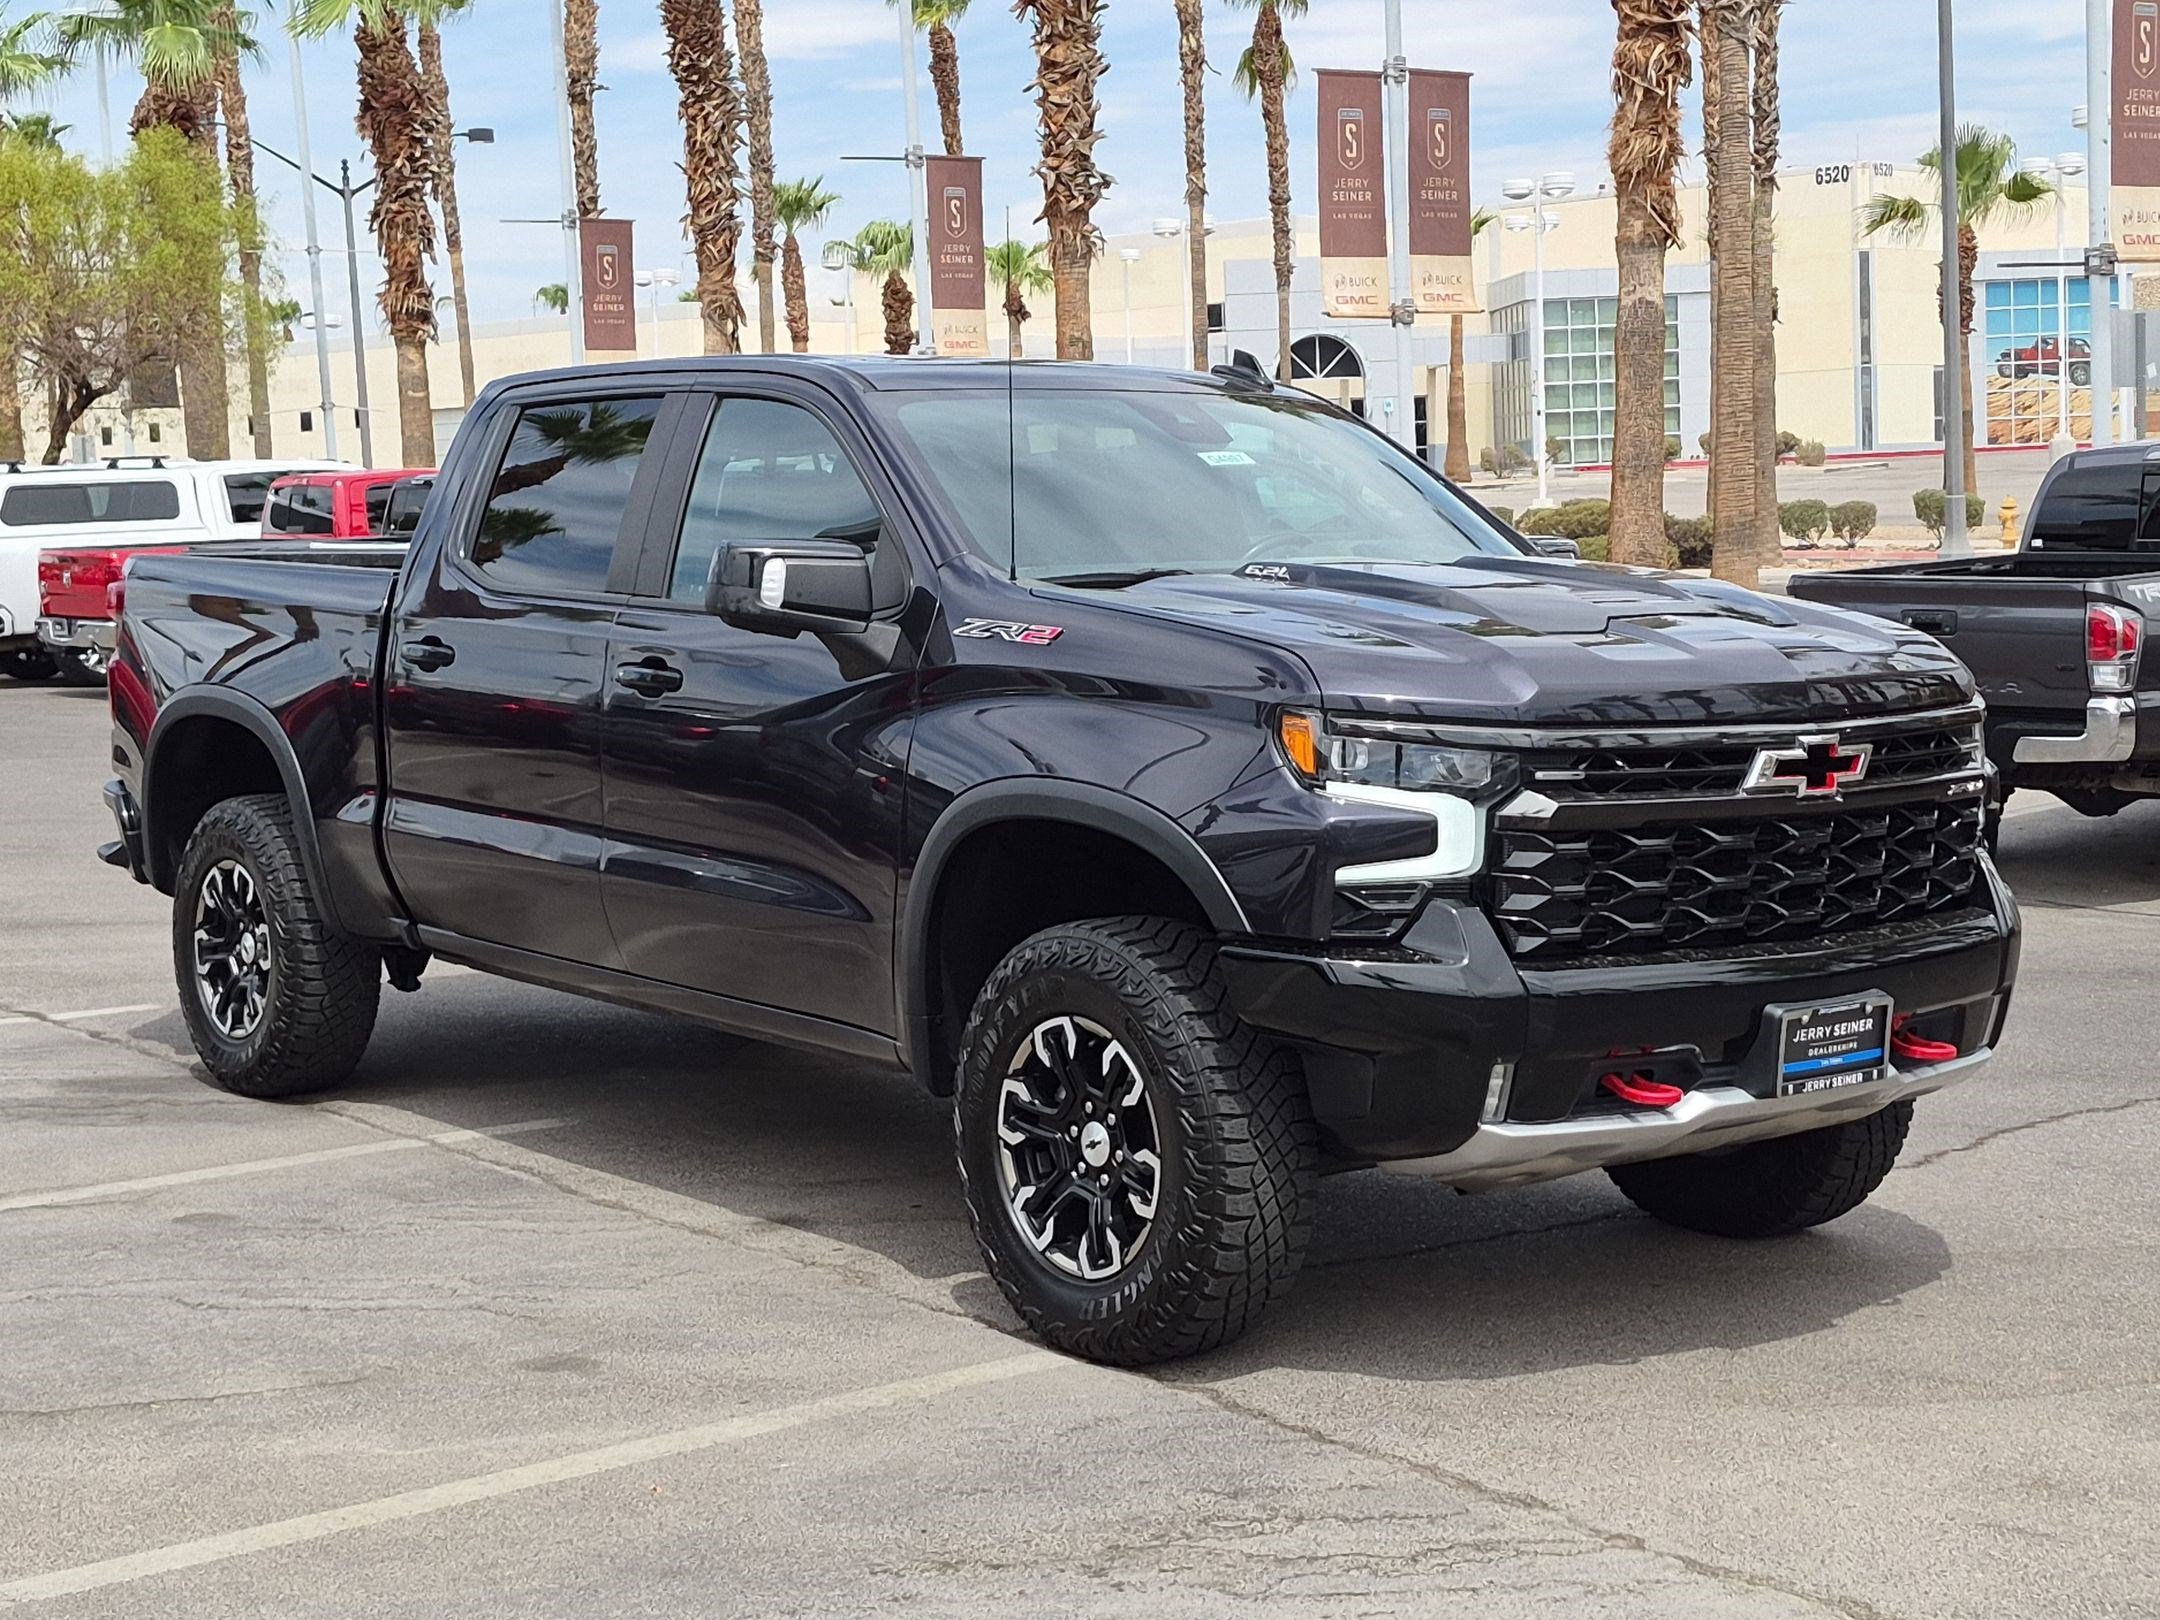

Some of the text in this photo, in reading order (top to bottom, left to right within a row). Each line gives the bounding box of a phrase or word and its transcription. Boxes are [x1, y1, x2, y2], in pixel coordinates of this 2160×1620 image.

[2126, 88, 2160, 100] JERRY
[1815, 164, 1850, 185] 6520
[1873, 163, 1893, 177] 6520
[1334, 178, 1369, 189] JERRY
[1423, 177, 1455, 188] JERRY
[1332, 191, 1372, 201] SEINER
[1420, 190, 1458, 201] SEINER
[943, 244, 971, 254] JERRY
[940, 254, 974, 264] SEINER
[1348, 277, 1377, 287] BUICK
[1436, 275, 1463, 285] BUICK
[1336, 295, 1378, 305] GMC
[1423, 293, 1465, 302] GMC
[592, 302, 625, 311] SEINER
[944, 340, 978, 349] GMC
[952, 617, 1066, 646] ZR2
[1793, 1018, 1874, 1042] JERRY SEINER
[1802, 1072, 1864, 1093] JERRY SEINER
